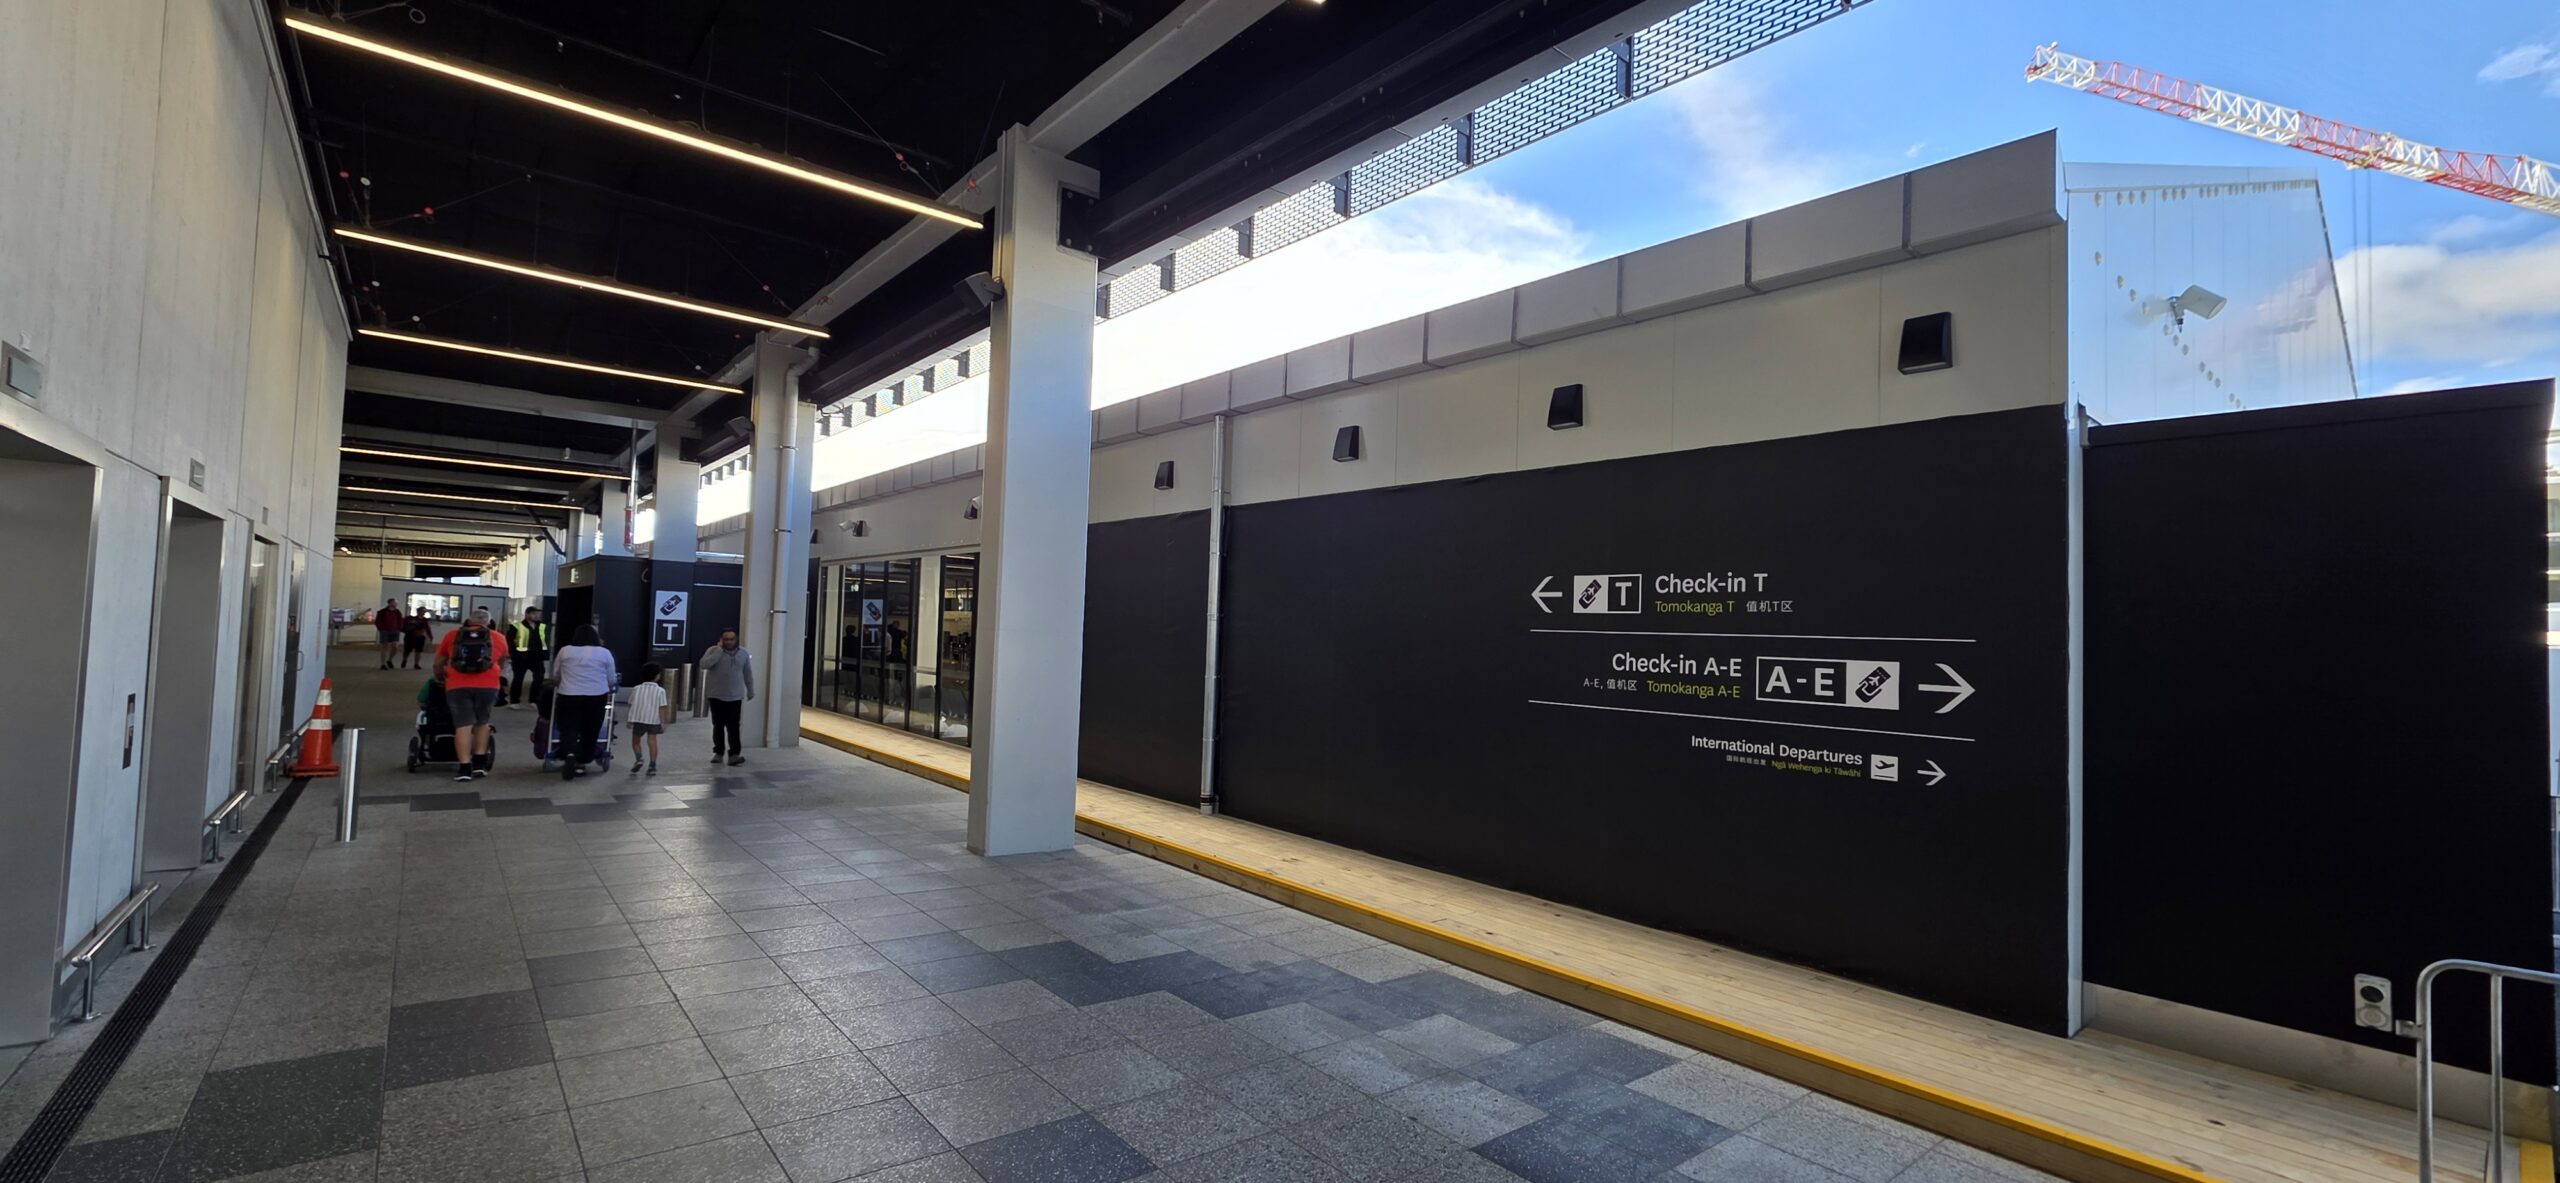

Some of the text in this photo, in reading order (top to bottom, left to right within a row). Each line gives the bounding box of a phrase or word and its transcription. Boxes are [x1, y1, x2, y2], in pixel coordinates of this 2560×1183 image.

[1614, 581, 1633, 607] T
[1655, 571, 1769, 594] Check-in T
[1655, 600, 1735, 617] Tomokanga T
[662, 623, 678, 641] T
[1612, 652, 1742, 677] Check-in A-E
[1646, 680, 1741, 699] Tomokanga A-E
[1765, 665, 1836, 697] A-E
[1691, 735, 1775, 756] International
[1779, 744, 1863, 765] Departures
